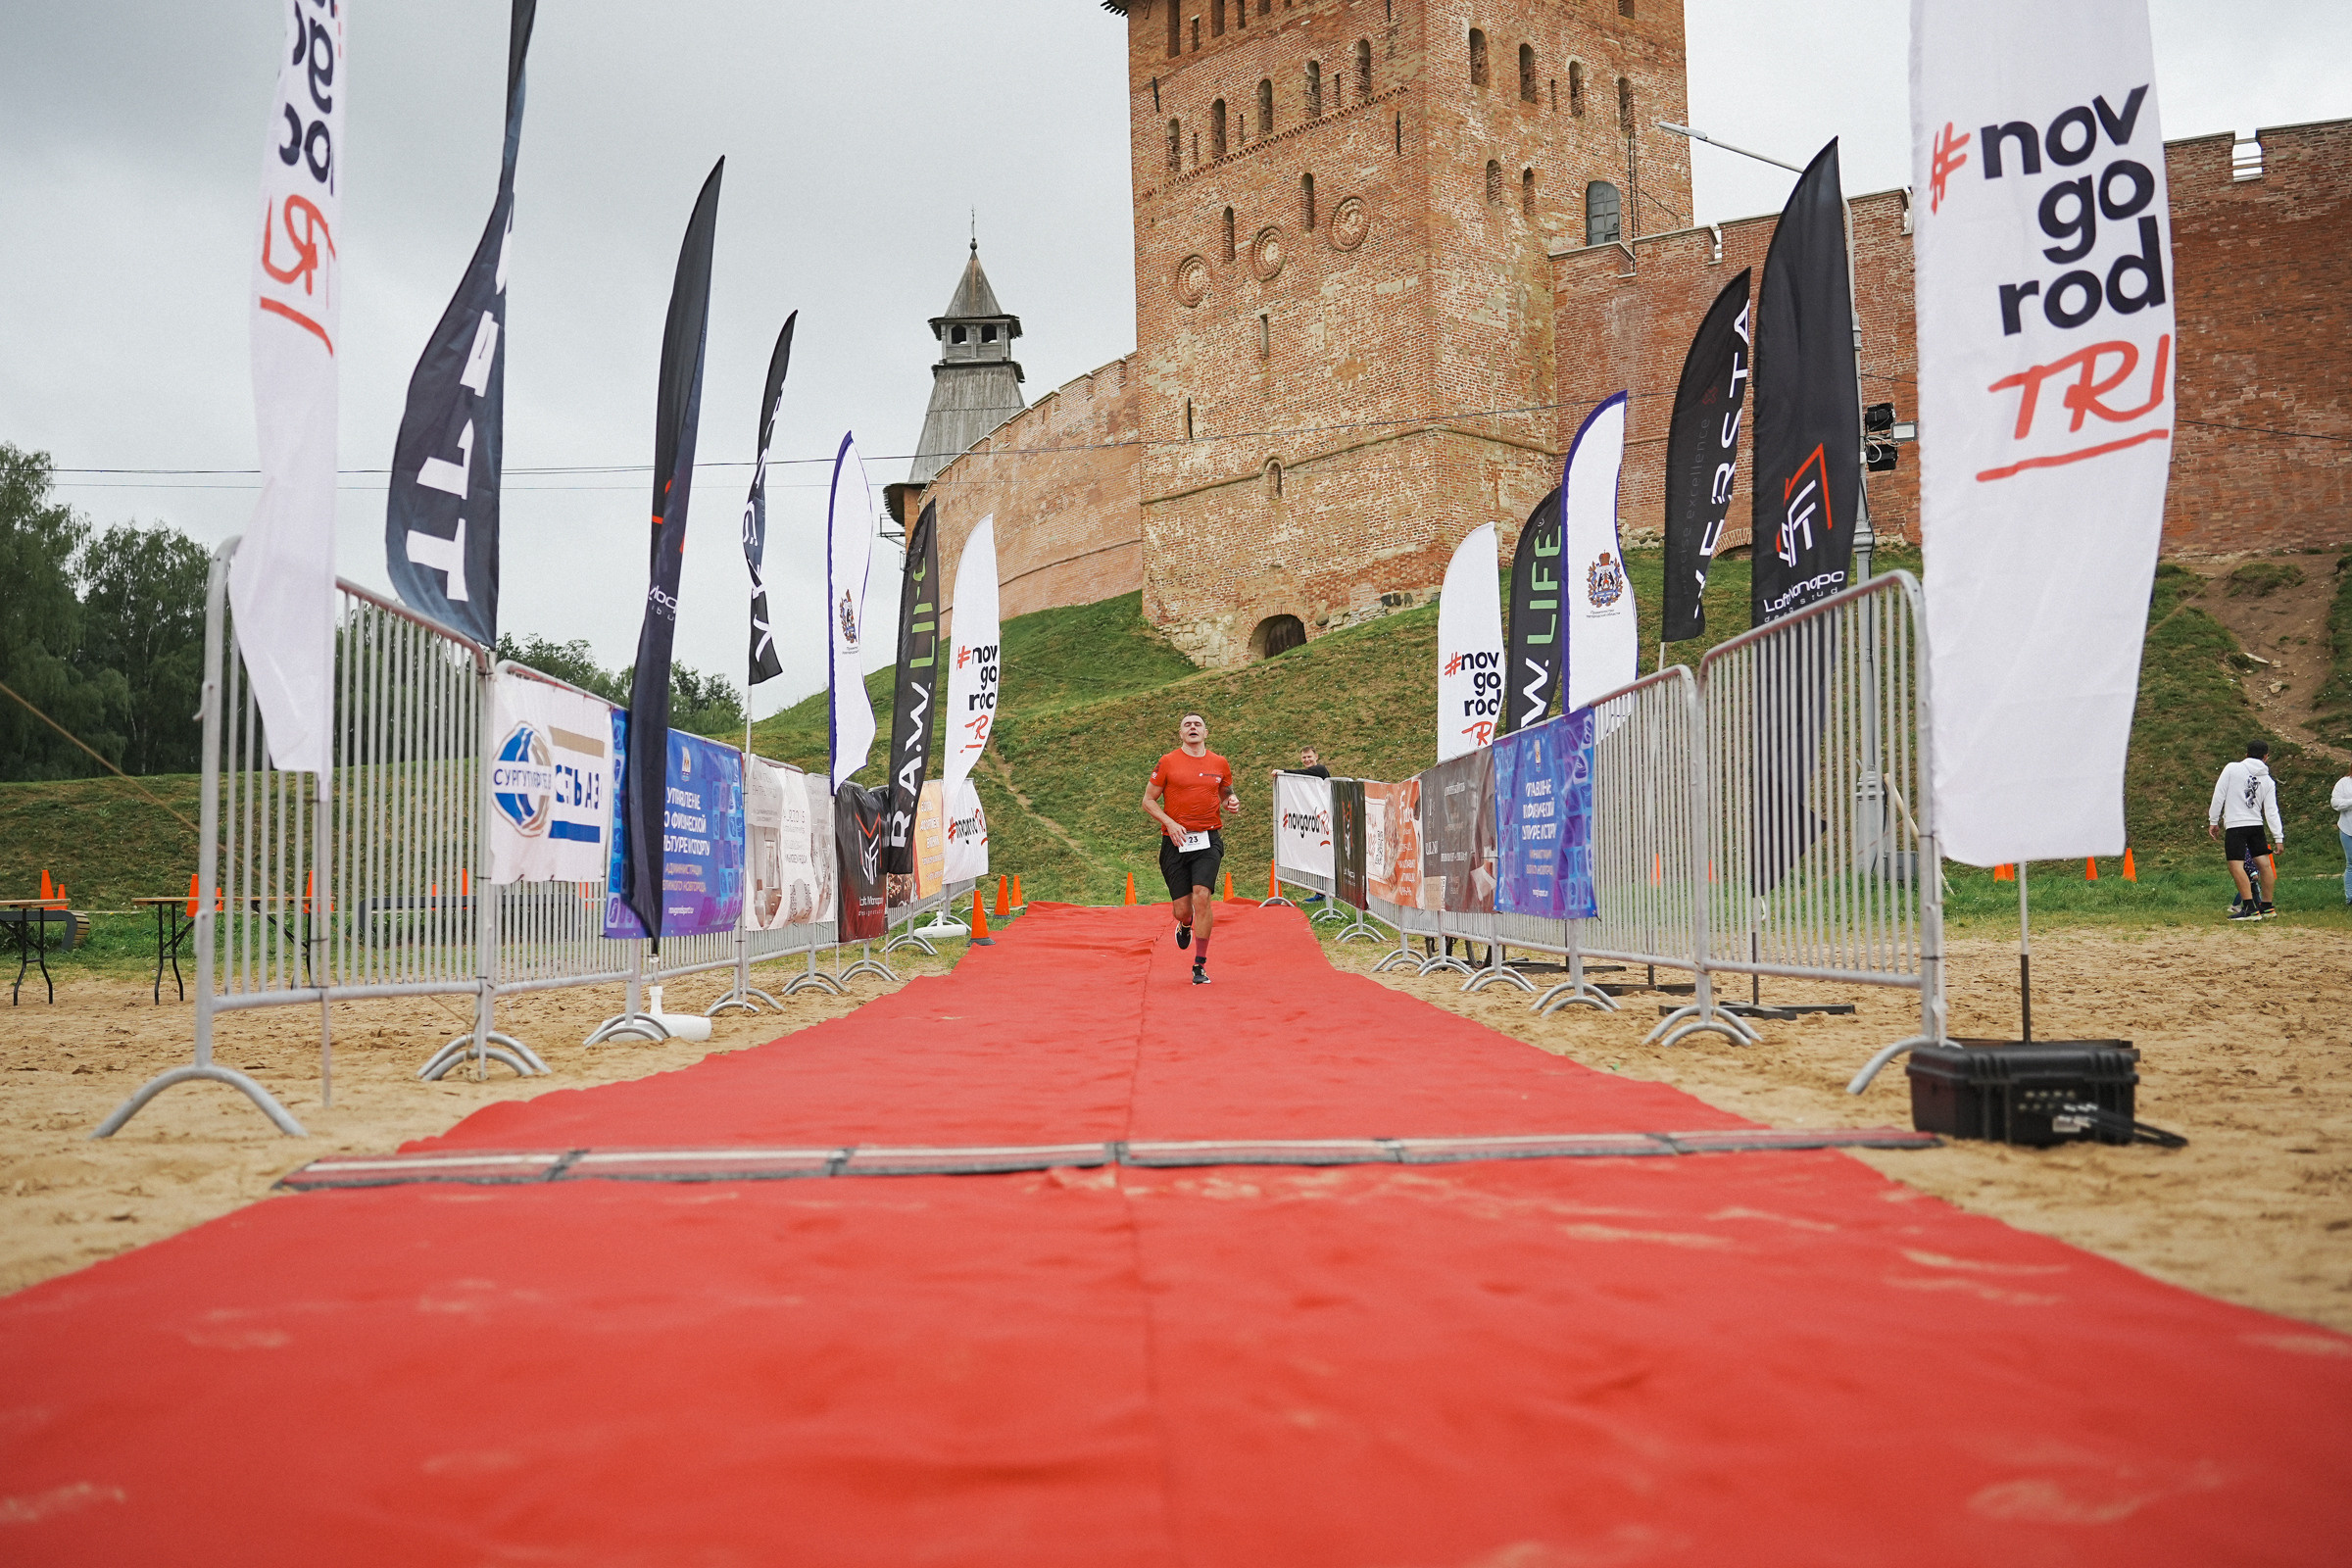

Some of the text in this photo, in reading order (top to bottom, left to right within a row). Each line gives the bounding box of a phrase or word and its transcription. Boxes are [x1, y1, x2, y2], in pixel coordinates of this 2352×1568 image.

[1930, 83, 2150, 216] #nov
[2038, 160, 2156, 265] go
[1998, 215, 2167, 336] rod
[1987, 334, 2171, 441] TRI
[1684, 417, 1710, 520] excellence
[1527, 525, 1561, 644] LIFE
[956, 645, 999, 671] #nov
[980, 665, 998, 691] go
[1444, 651, 1500, 677] #nov
[1463, 689, 1502, 717] rod
[1473, 671, 1501, 697] go
